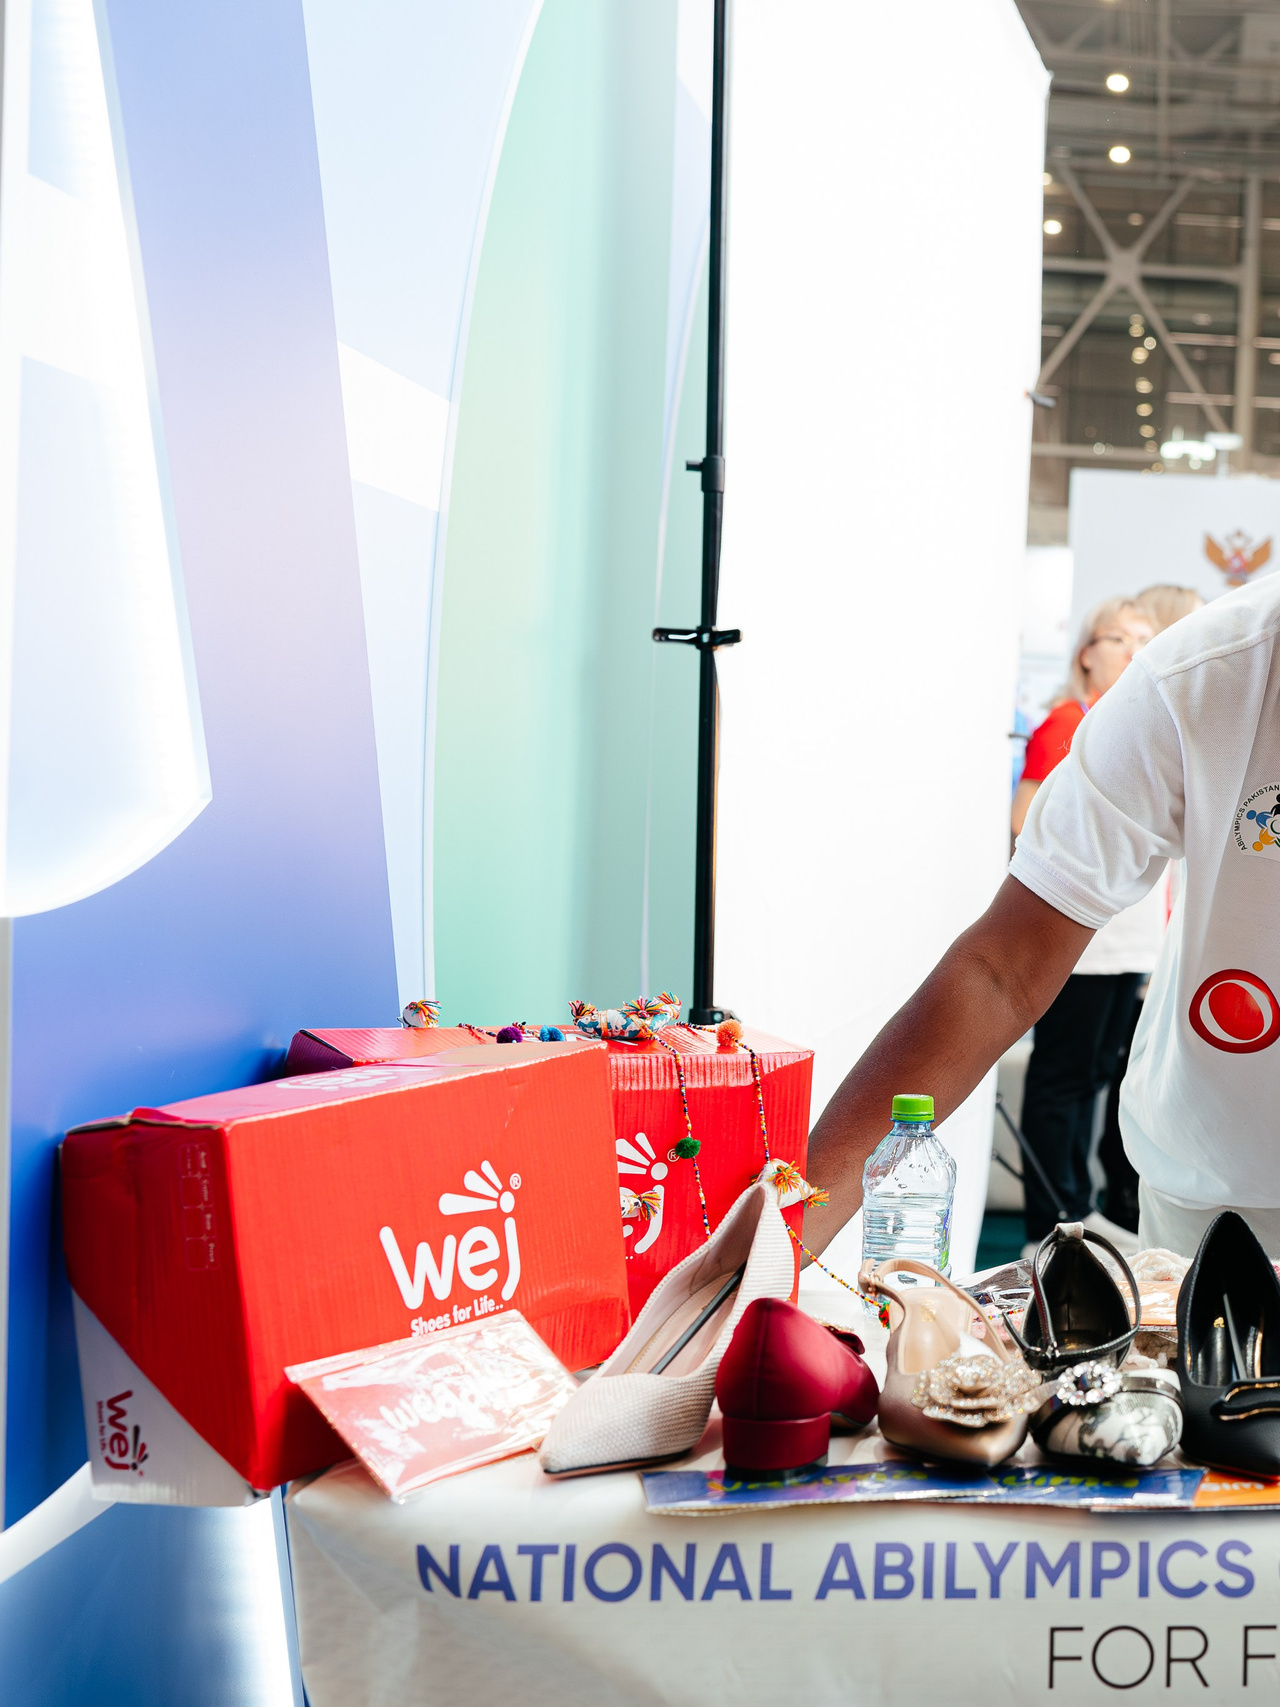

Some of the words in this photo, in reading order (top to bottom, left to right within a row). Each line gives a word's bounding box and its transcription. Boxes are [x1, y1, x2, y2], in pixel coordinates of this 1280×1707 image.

[1234, 807, 1247, 851] ABILYMPICS
[1243, 784, 1280, 807] PAKISTAN
[410, 1311, 451, 1337] Shoes
[452, 1304, 472, 1324] for
[416, 1542, 793, 1603] NATIONAL
[814, 1540, 1256, 1601] ABILYMPICS
[1048, 1625, 1209, 1690] FOR
